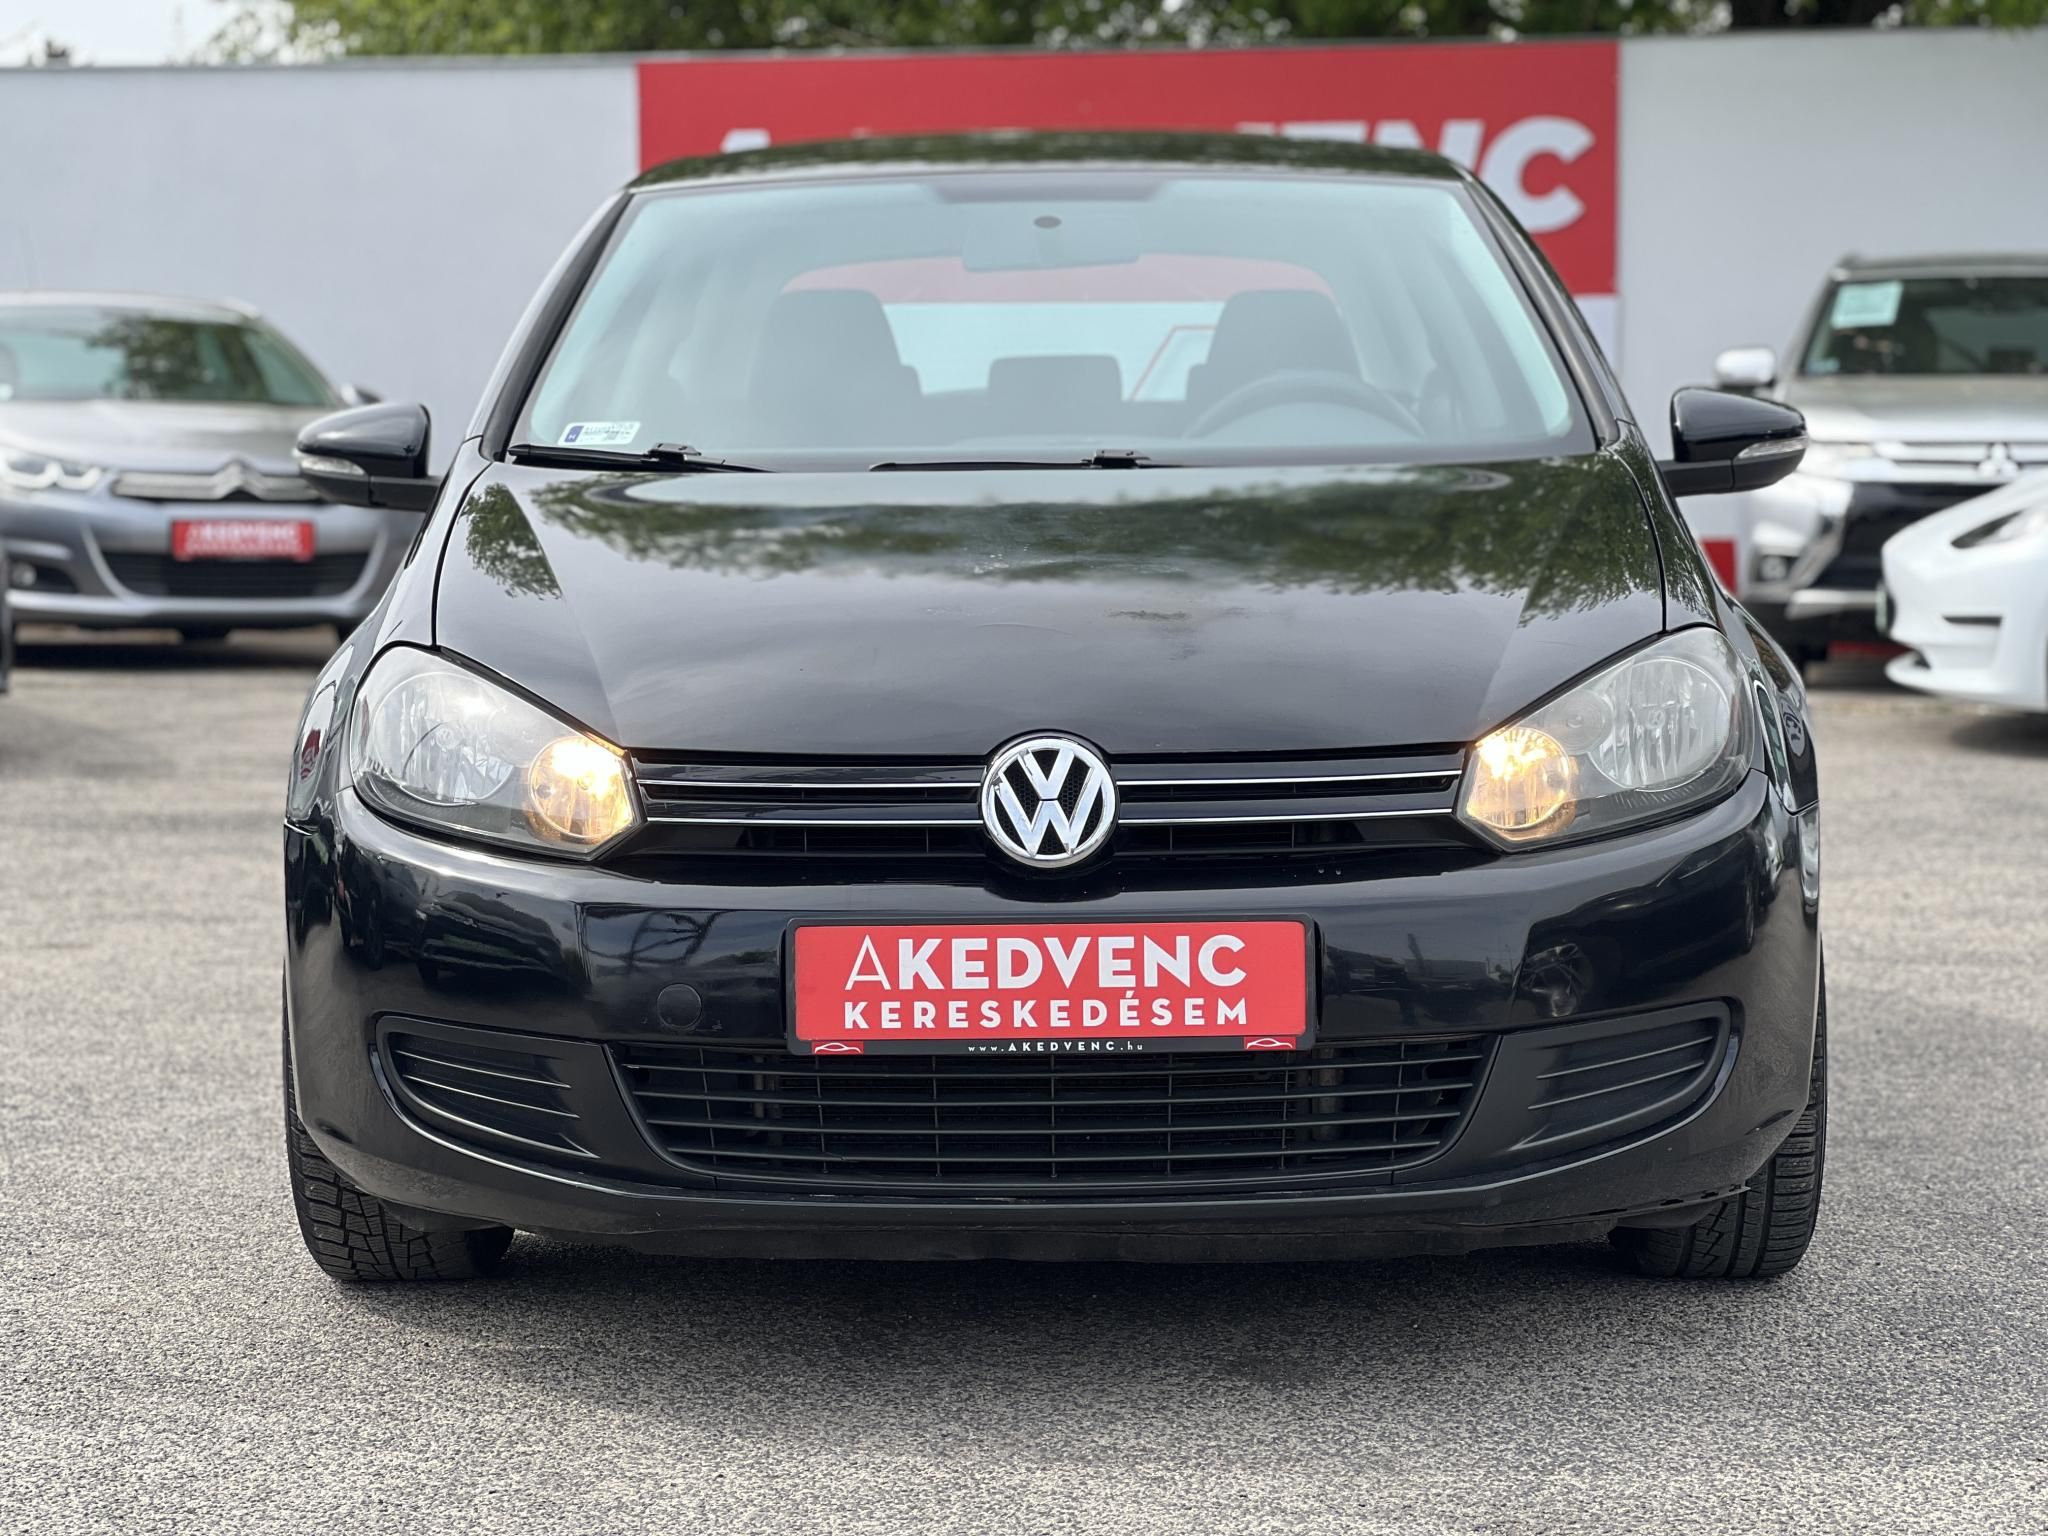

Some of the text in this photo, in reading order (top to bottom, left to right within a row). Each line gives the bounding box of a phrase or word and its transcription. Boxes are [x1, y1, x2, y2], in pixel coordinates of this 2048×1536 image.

[994, 747, 1102, 858] VW
[844, 934, 1247, 991] AKEDVENC
[844, 991, 1247, 1029] KERESKEDÉSEM
[967, 1039, 1143, 1052] www.AKEDVENC.hu
